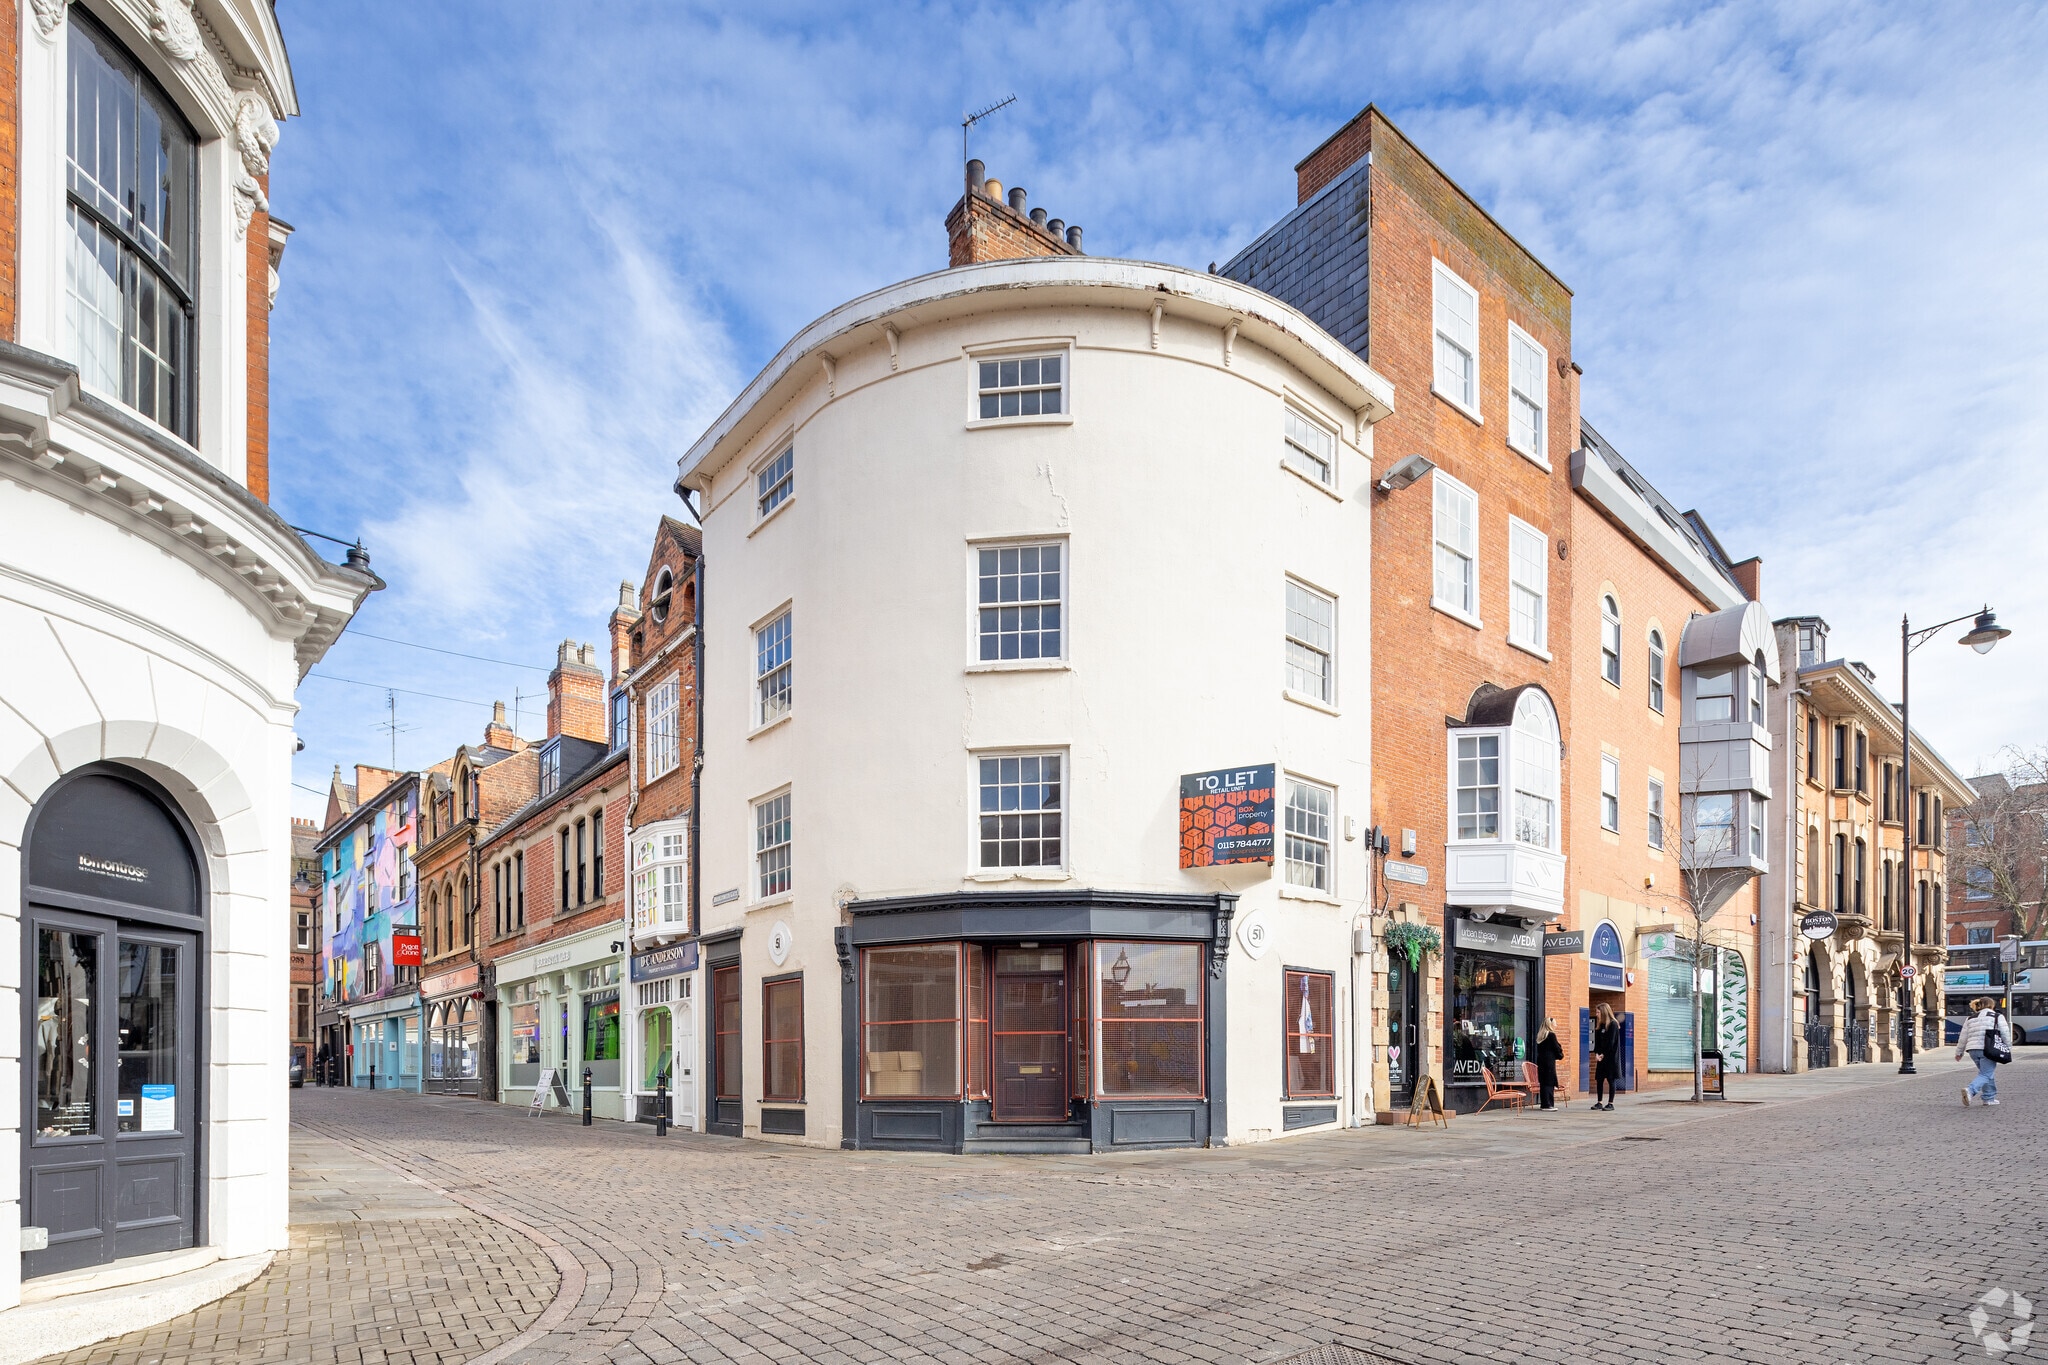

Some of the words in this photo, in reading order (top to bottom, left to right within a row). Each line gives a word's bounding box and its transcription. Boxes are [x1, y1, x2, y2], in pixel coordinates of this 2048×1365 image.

[1196, 776, 1219, 791] TO
[1225, 770, 1258, 787] LET
[1238, 811, 1268, 820] property
[1217, 841, 1235, 850] 0115
[1236, 838, 1272, 848] 7844777
[1805, 916, 1833, 924] BOSTON
[1252, 928, 1262, 940] 51
[1461, 928, 1478, 938] urban
[1478, 930, 1499, 943] therapy
[1510, 933, 1537, 948] AVEDA
[1543, 936, 1582, 948] AVEDA
[401, 943, 419, 951] Pygott
